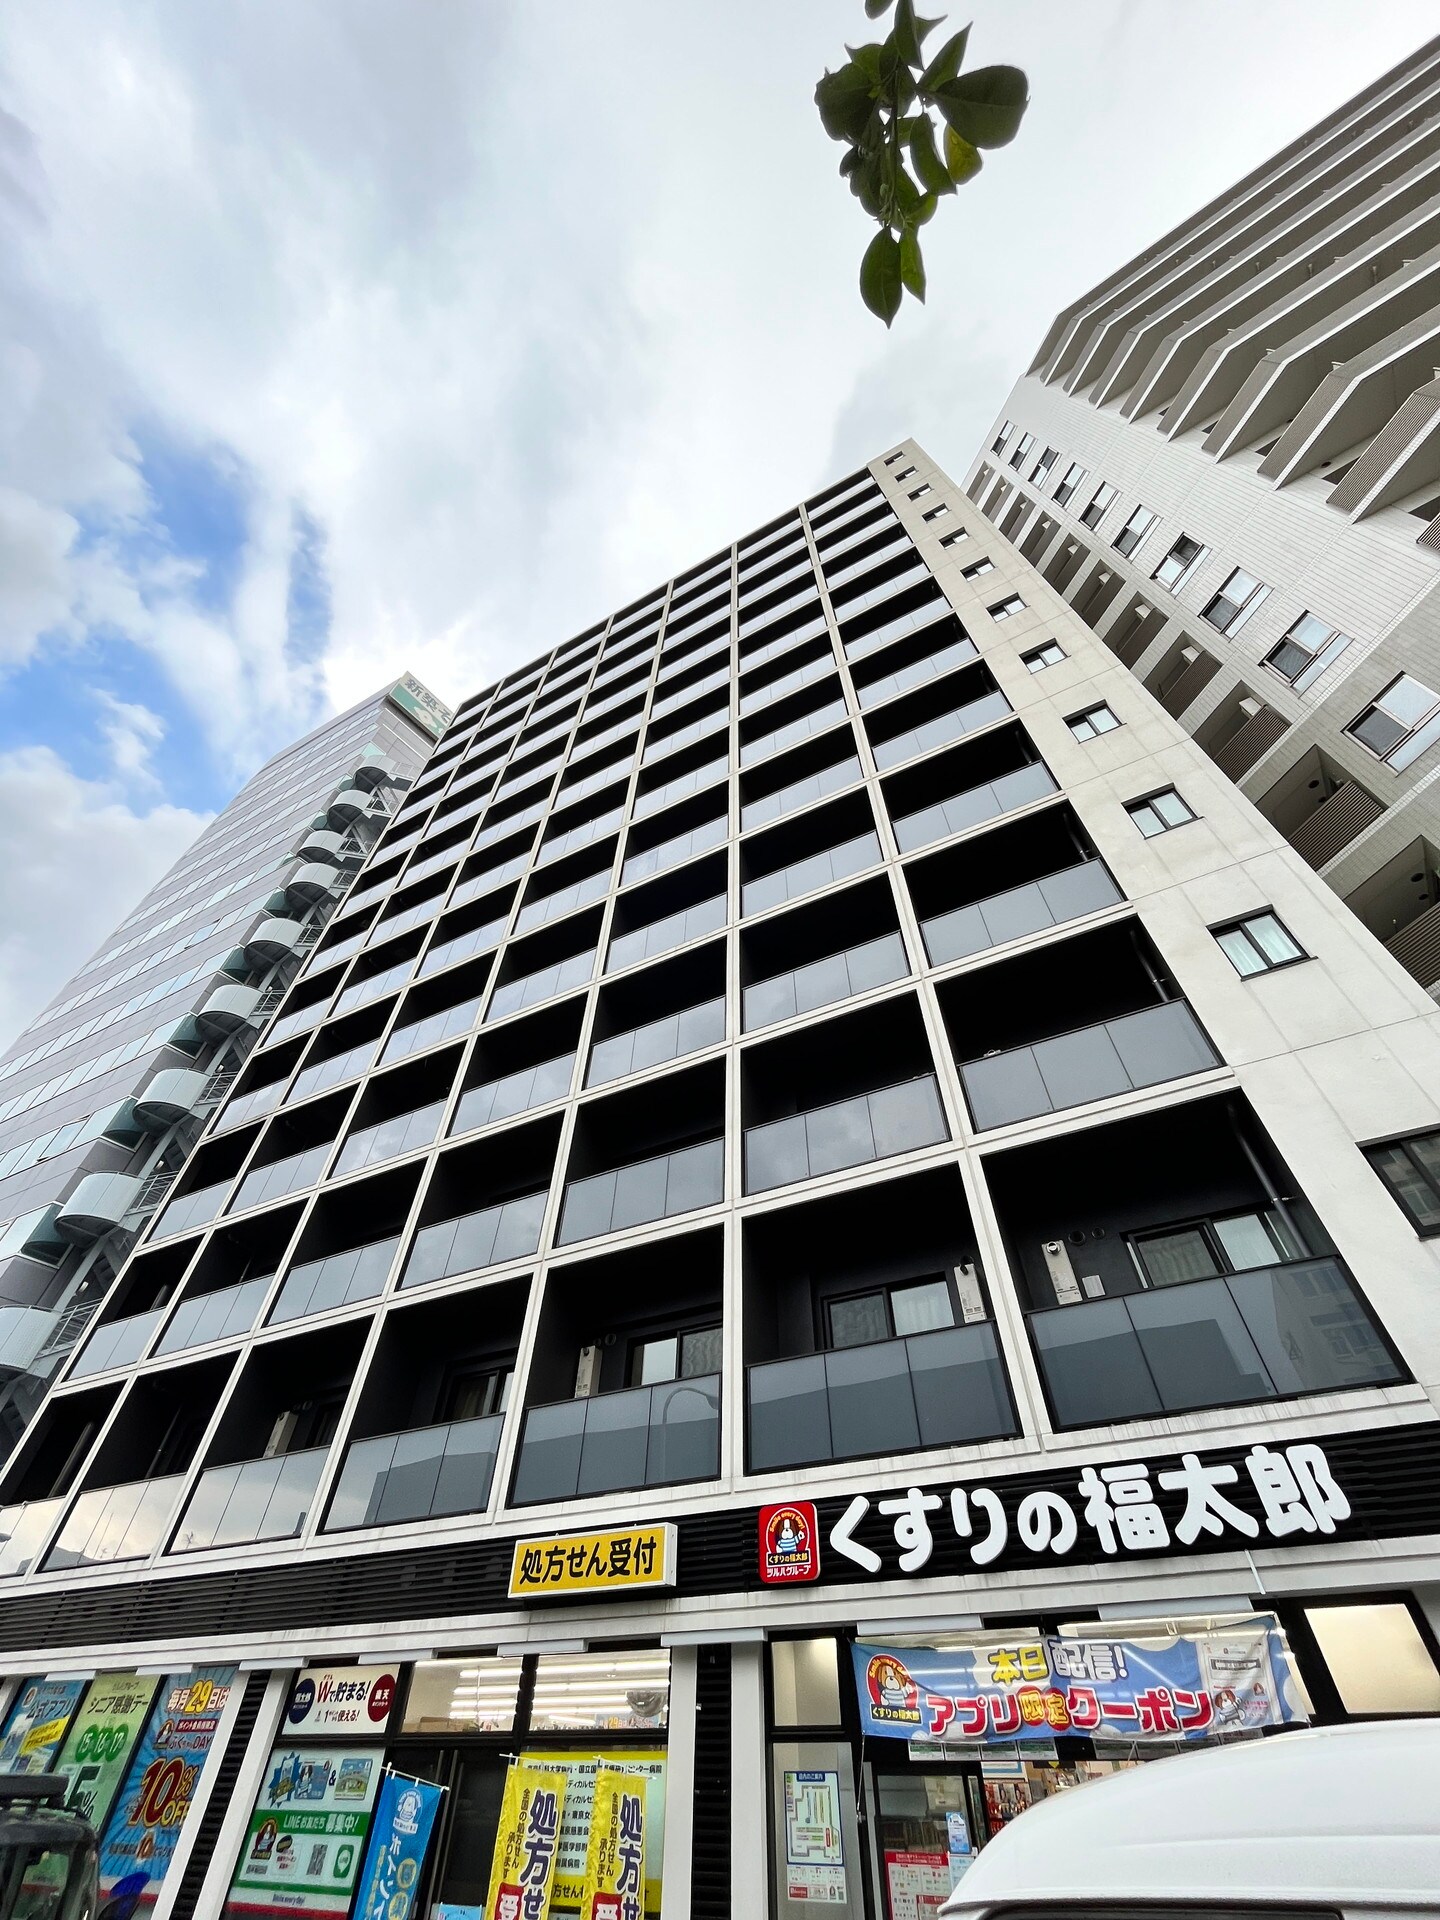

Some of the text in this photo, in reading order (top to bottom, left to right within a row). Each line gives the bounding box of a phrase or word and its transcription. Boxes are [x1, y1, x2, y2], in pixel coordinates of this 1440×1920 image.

[828, 1443, 1352, 1574] くすりの福太郎
[518, 1535, 658, 1585] 処方せん受付
[766, 1564, 812, 1578] ツルハグループ
[926, 1684, 1216, 1736] アプリ限定クーポン
[563, 1794, 595, 1804] ディカルセ
[566, 1779, 597, 1789] ディカルセ
